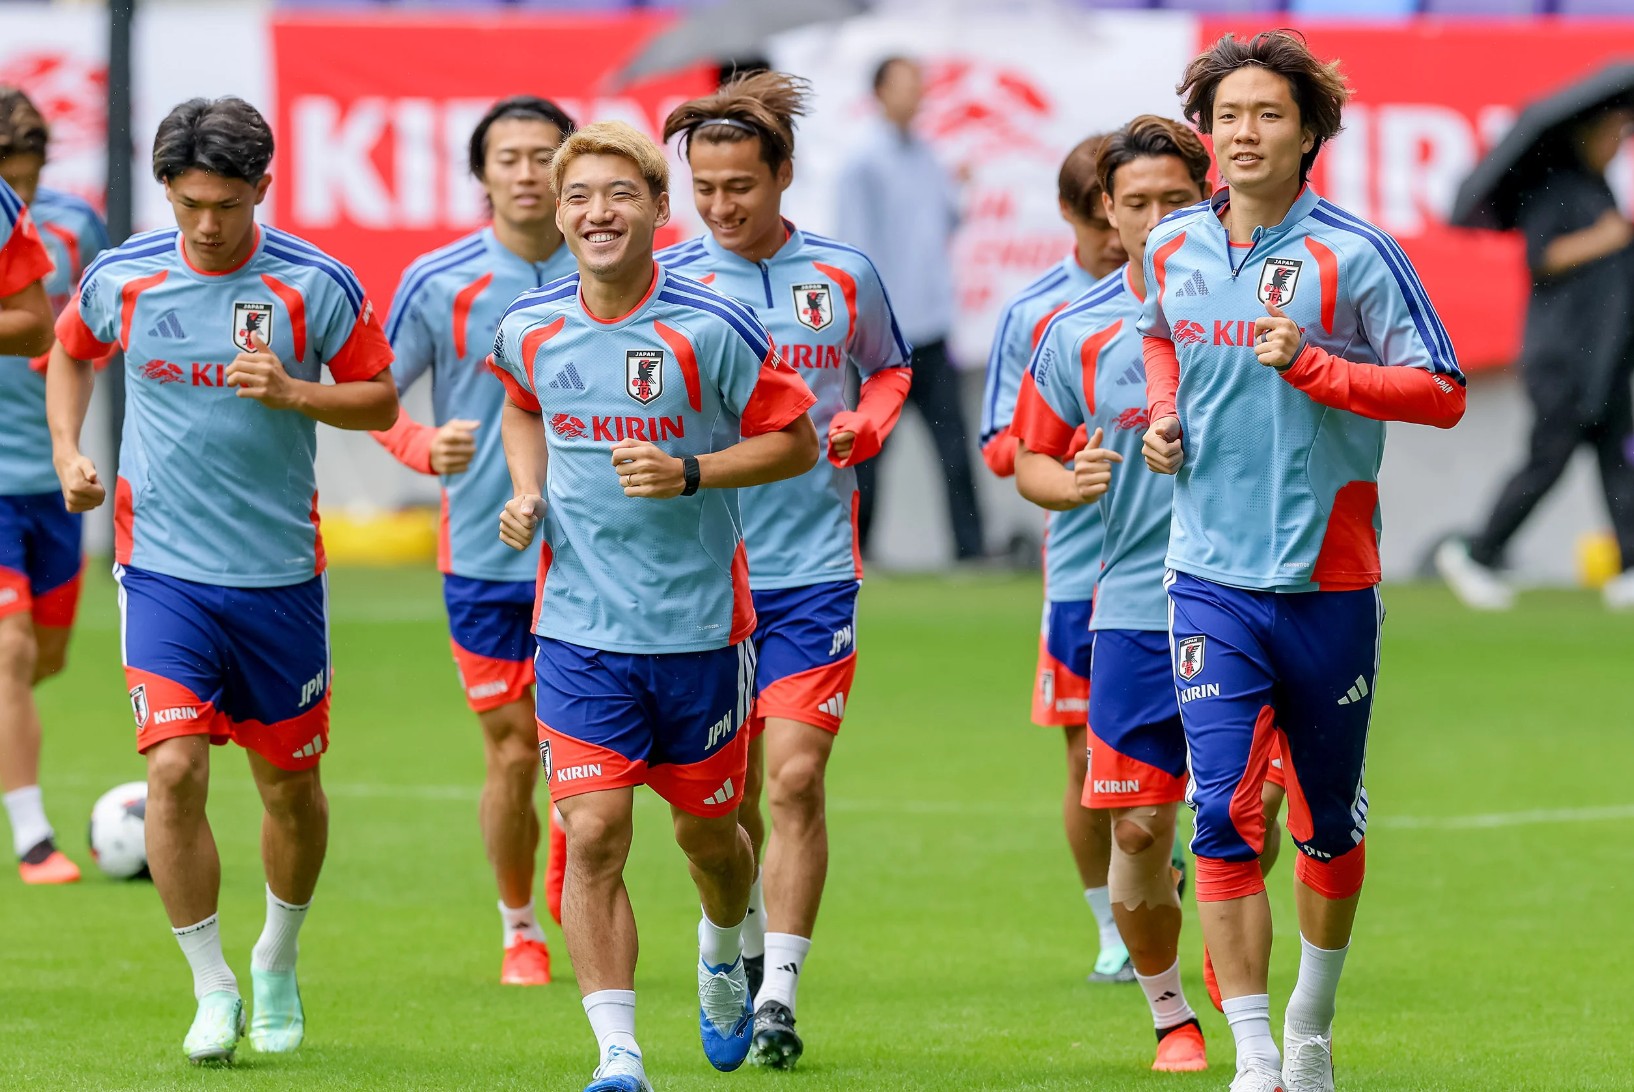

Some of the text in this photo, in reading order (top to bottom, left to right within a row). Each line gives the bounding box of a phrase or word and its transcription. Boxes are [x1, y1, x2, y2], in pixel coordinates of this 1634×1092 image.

[1266, 293, 1283, 302] JFA
[774, 344, 842, 369] IRIN
[1036, 347, 1055, 387] DREAM
[635, 387, 653, 396] JFA
[1432, 374, 1454, 394] JAPAN
[591, 415, 685, 442] KIRIN
[828, 625, 852, 656] JPN
[298, 670, 324, 708] JPN
[1180, 682, 1220, 704] KIRIN
[154, 707, 198, 724] KIRIN
[704, 709, 732, 751] JPN
[557, 763, 602, 782] KIRIN
[1093, 779, 1140, 794] KIRIN
